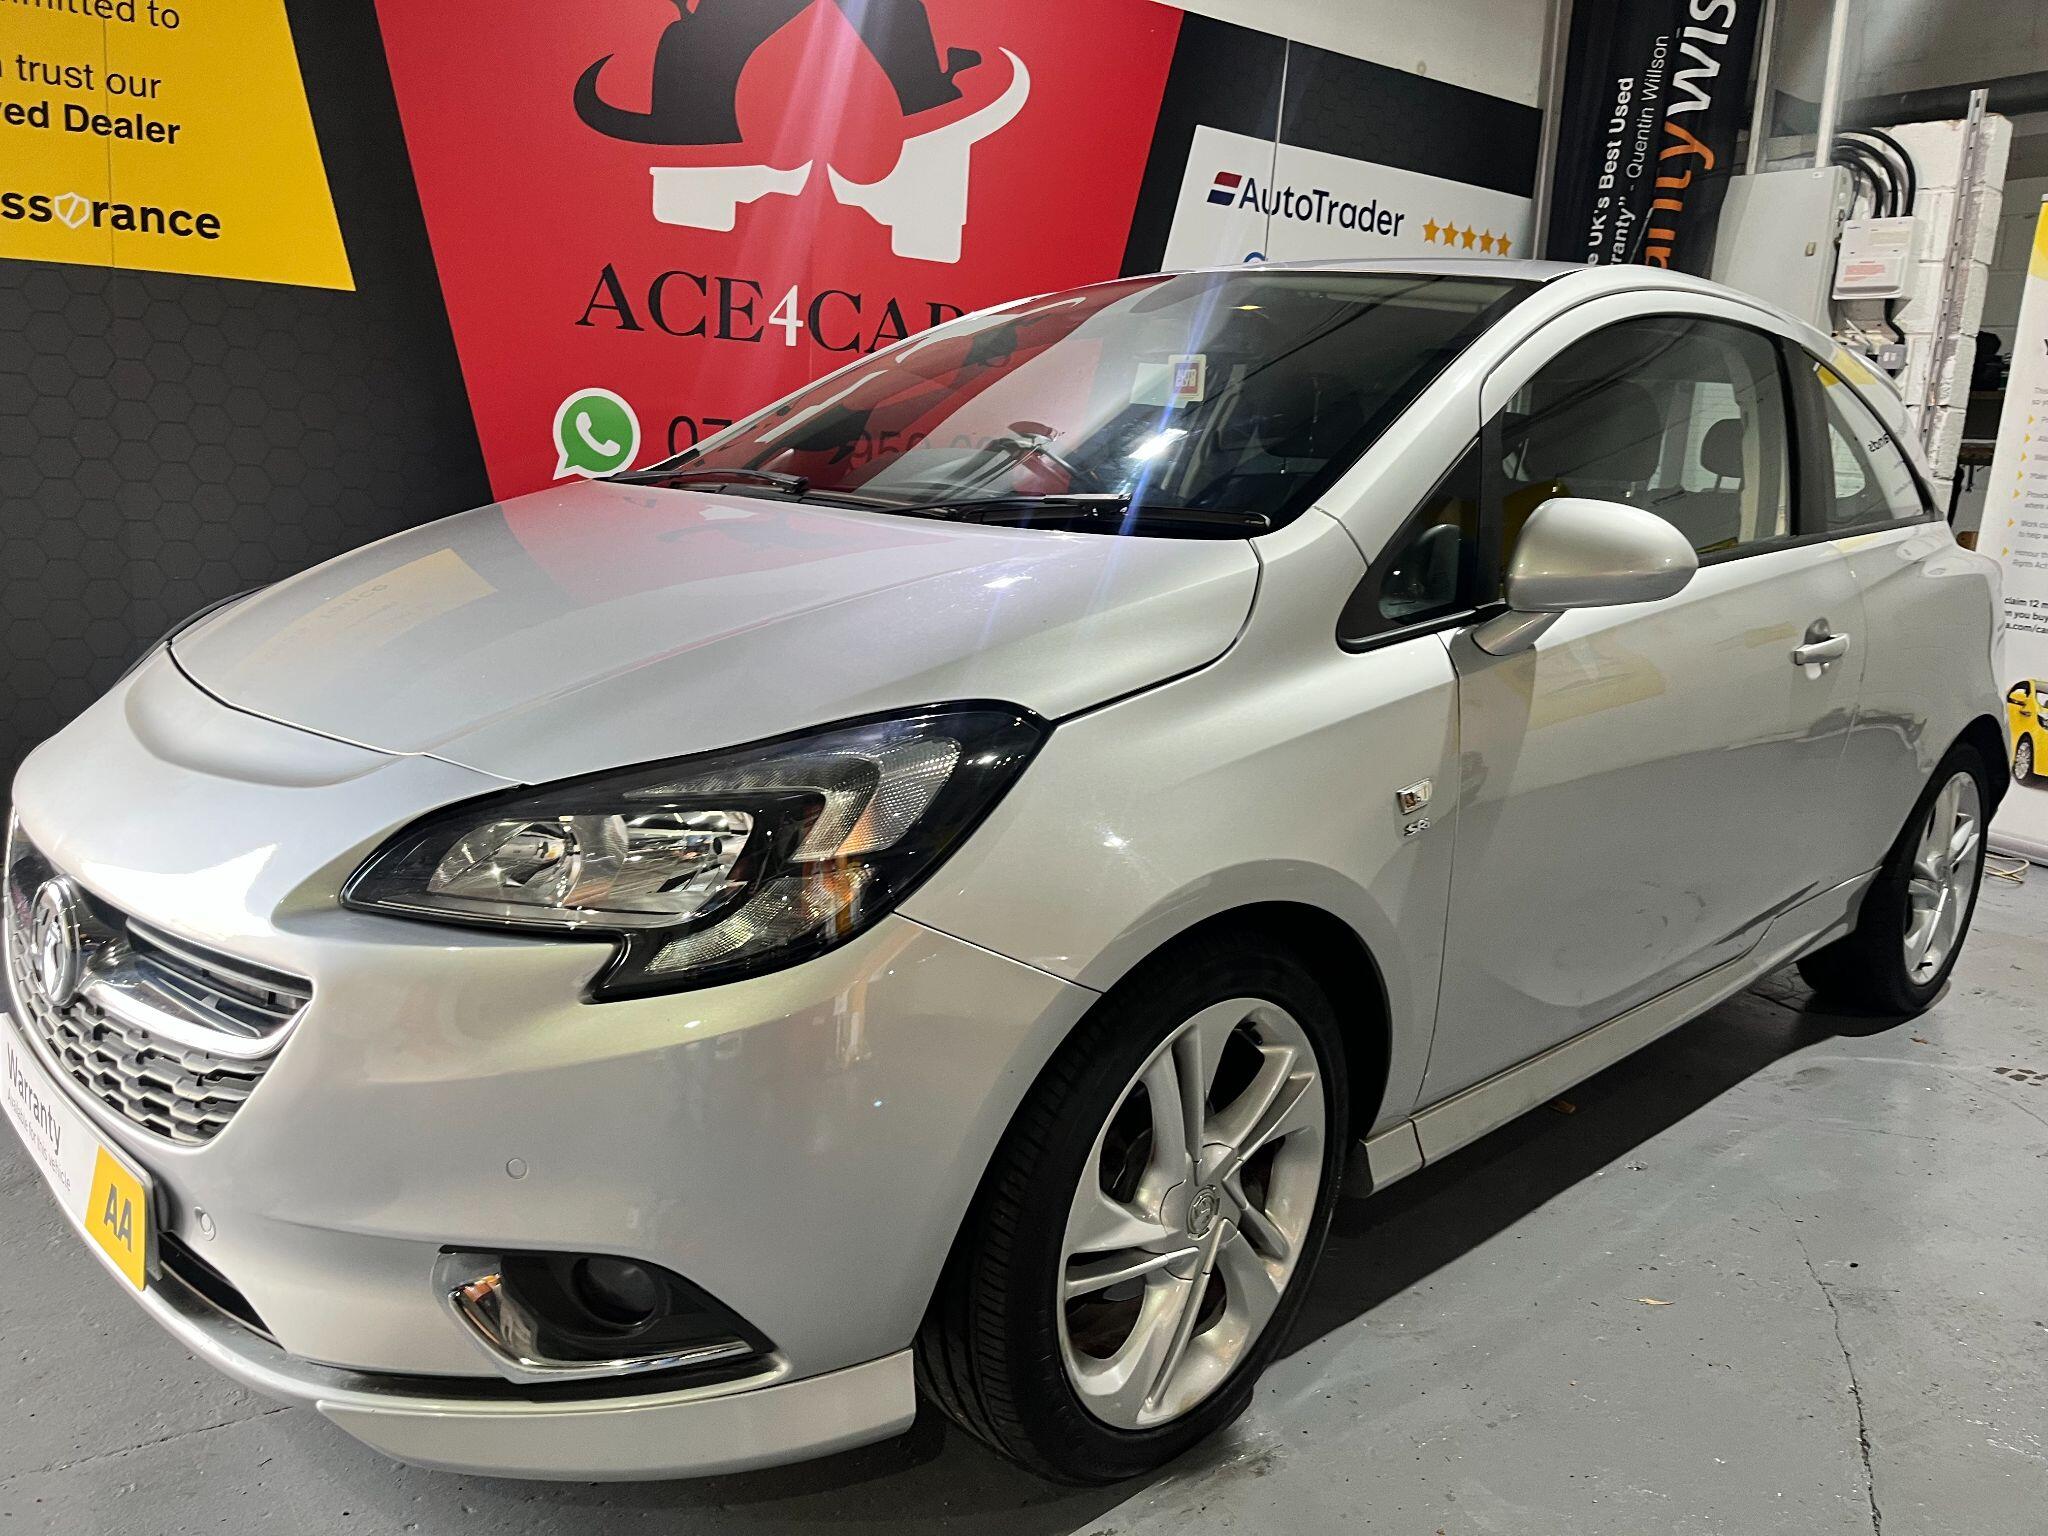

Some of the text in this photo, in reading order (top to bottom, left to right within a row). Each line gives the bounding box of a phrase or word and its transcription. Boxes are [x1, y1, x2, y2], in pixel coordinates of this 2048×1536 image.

[147, 0, 180, 29] to
[16, 54, 161, 98] trust our
[1640, 35, 1669, 102] Willson
[64, 103, 180, 144] Dealer
[1608, 77, 1635, 134] Used
[1598, 139, 1622, 190] Best
[1626, 107, 1655, 179] Quentin
[1239, 177, 1405, 237] AutoTrader
[7, 1042, 61, 1156] Warranty
[103, 1183, 132, 1253] AA
